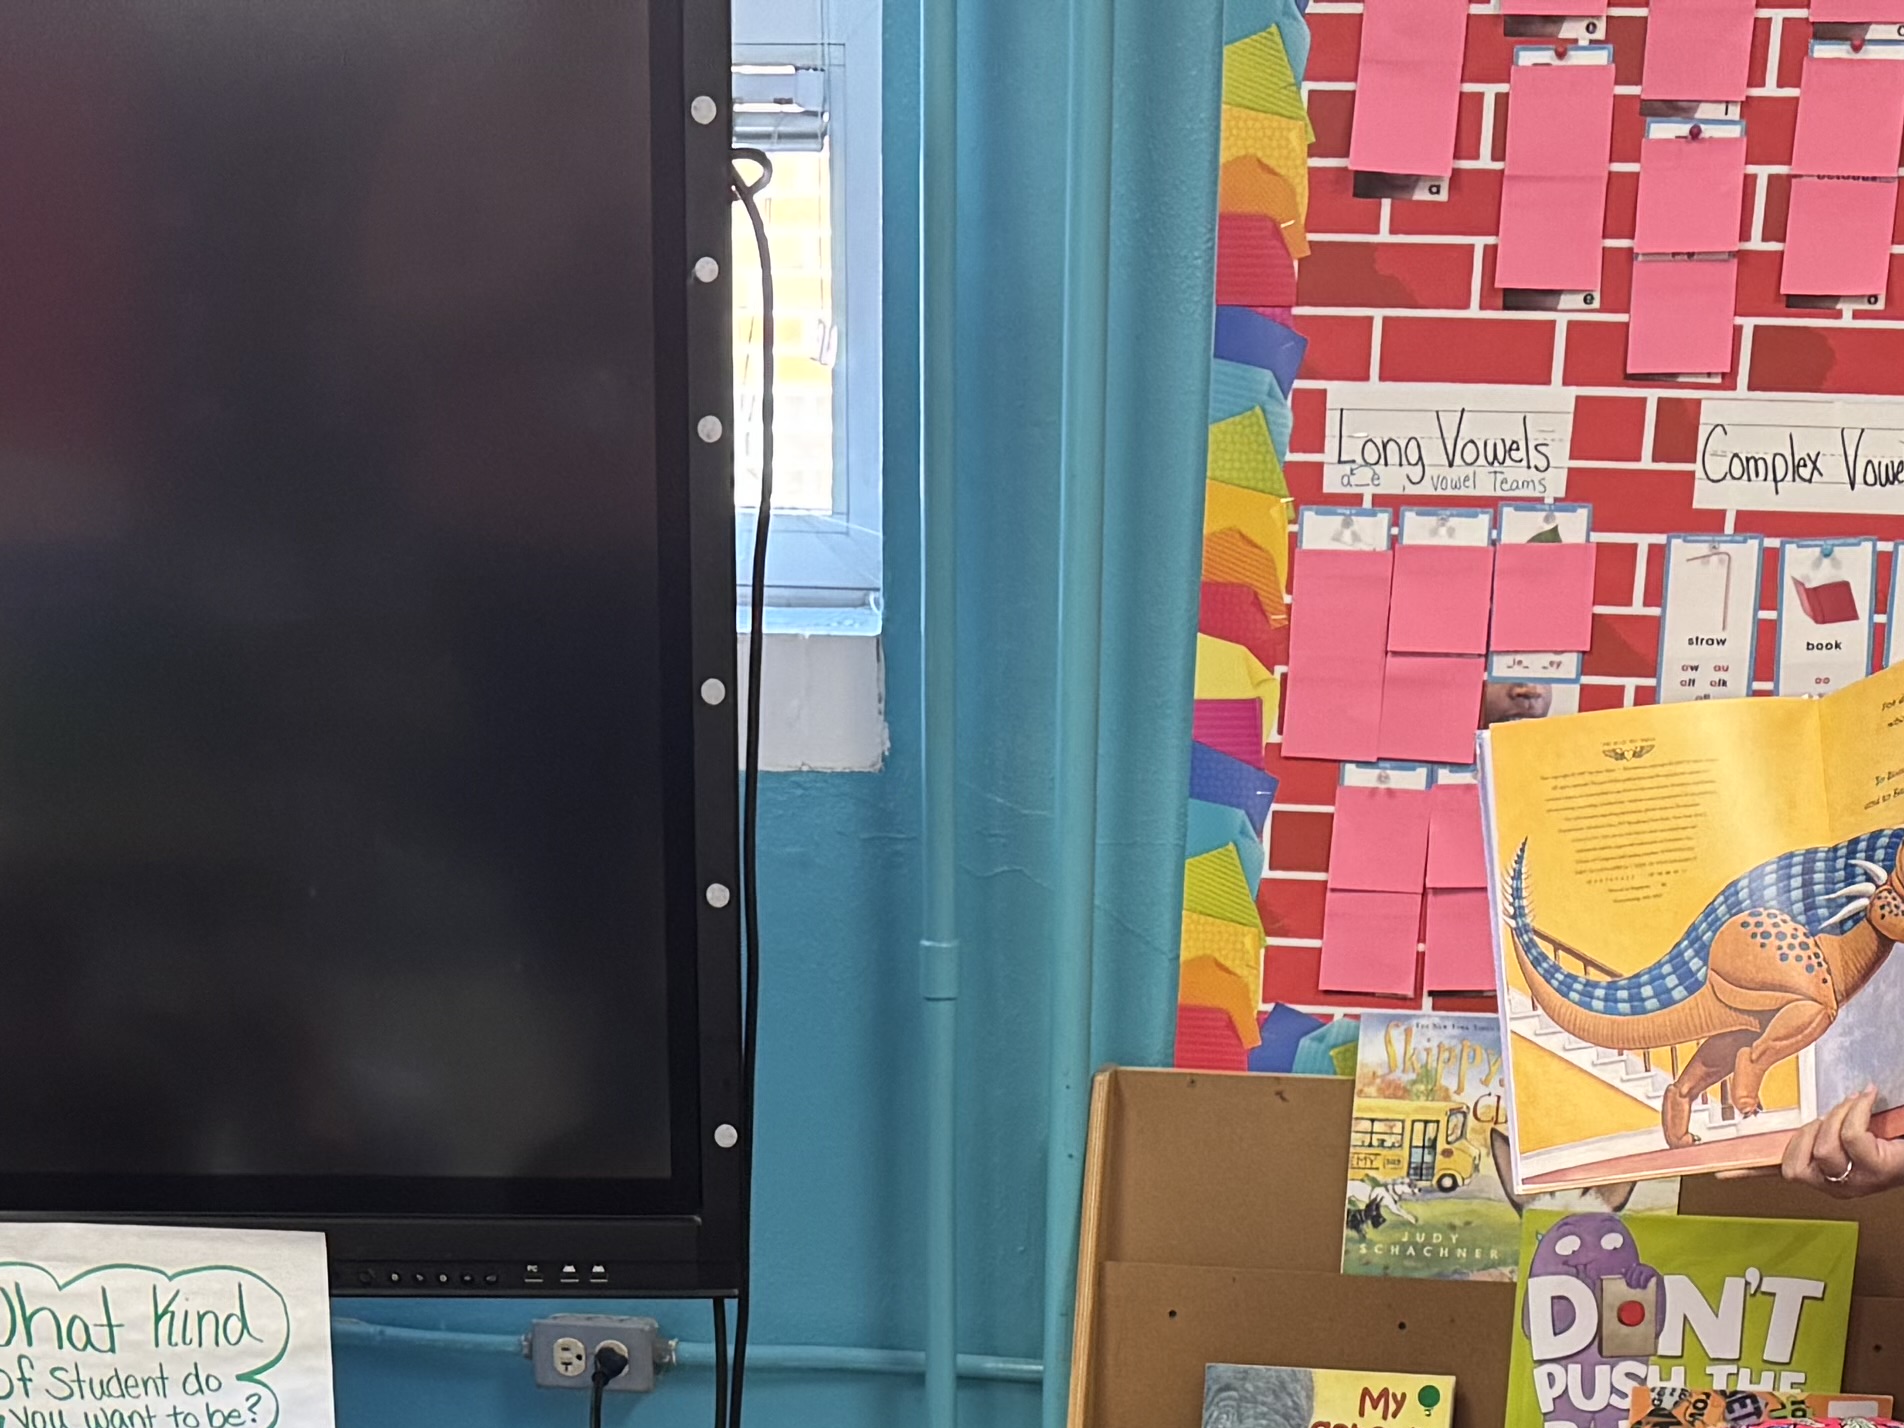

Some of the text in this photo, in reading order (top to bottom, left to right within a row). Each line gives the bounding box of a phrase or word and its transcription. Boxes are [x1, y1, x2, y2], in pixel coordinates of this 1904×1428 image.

[1428, 183, 1441, 196] a
[1582, 293, 1596, 306] e
[1337, 407, 1550, 485] Long Vowels
[1701, 423, 1824, 495] Complex
[1688, 636, 1728, 647] straw
[1806, 640, 1842, 651] book
[1401, 1231, 1460, 1244] JUDY
[1359, 1243, 1500, 1260] SCHACHNER
[183, 1360, 223, 1395] do
[165, 1404, 199, 1428] to
[206, 1392, 264, 1427] be?
[1358, 1386, 1407, 1420] My
